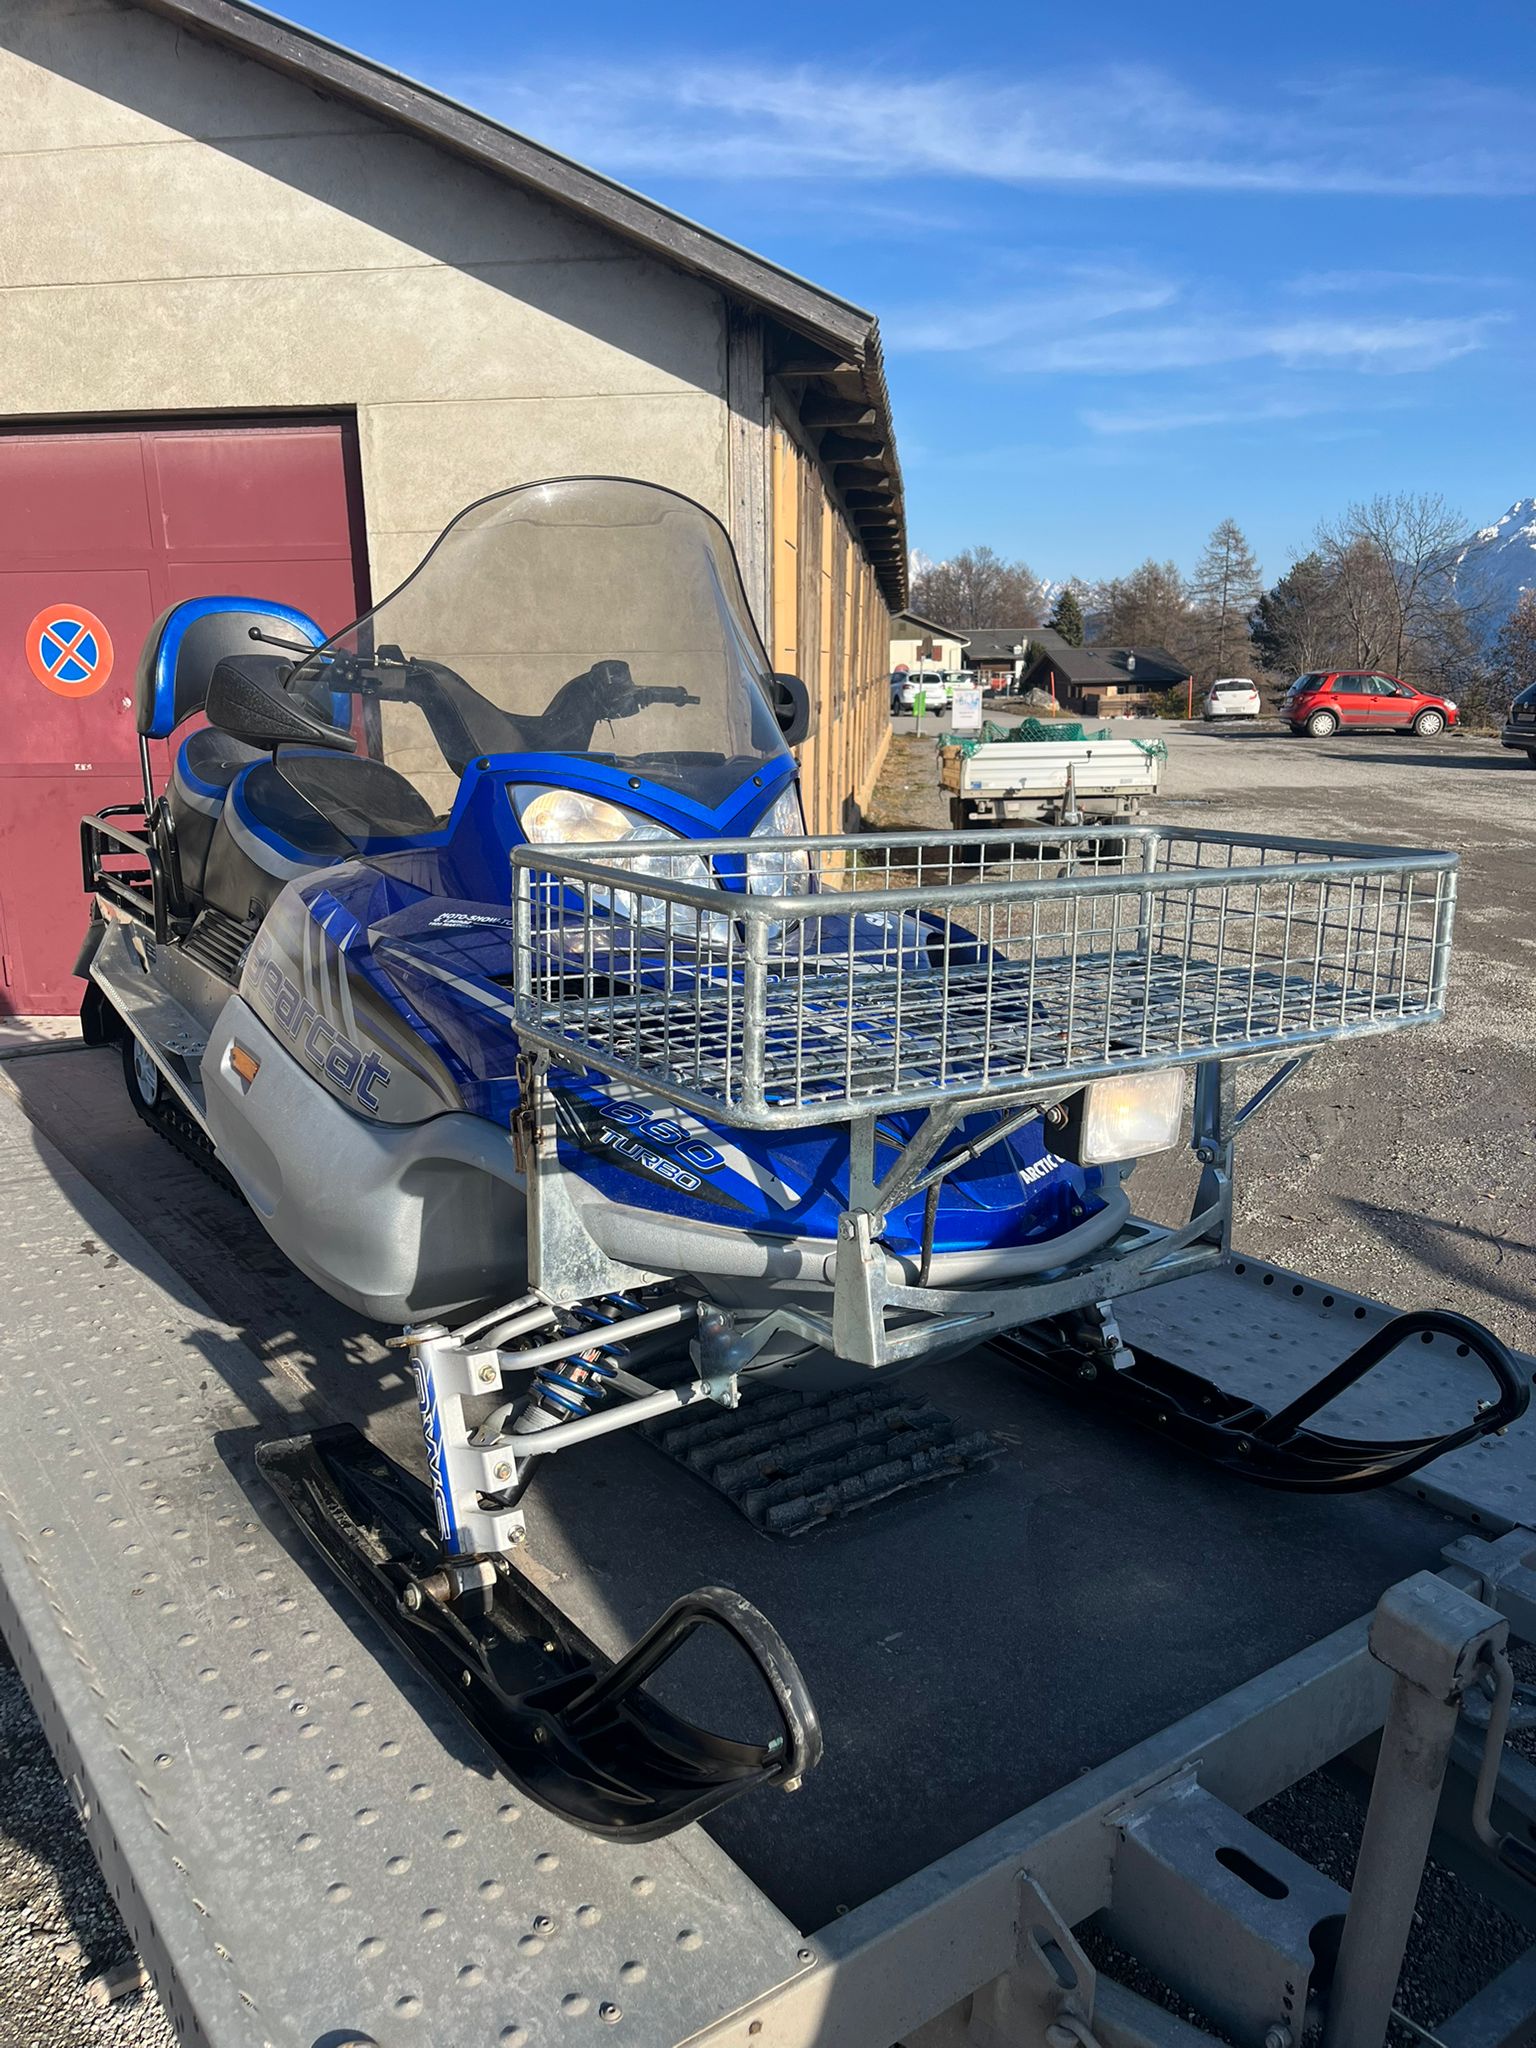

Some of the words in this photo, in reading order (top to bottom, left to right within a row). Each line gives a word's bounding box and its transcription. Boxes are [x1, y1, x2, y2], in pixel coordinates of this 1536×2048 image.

[245, 926, 391, 1112] Bearcat
[600, 1100, 726, 1170] 660
[600, 1126, 701, 1191] TURBO
[1019, 1154, 1059, 1184] ARCTIC
